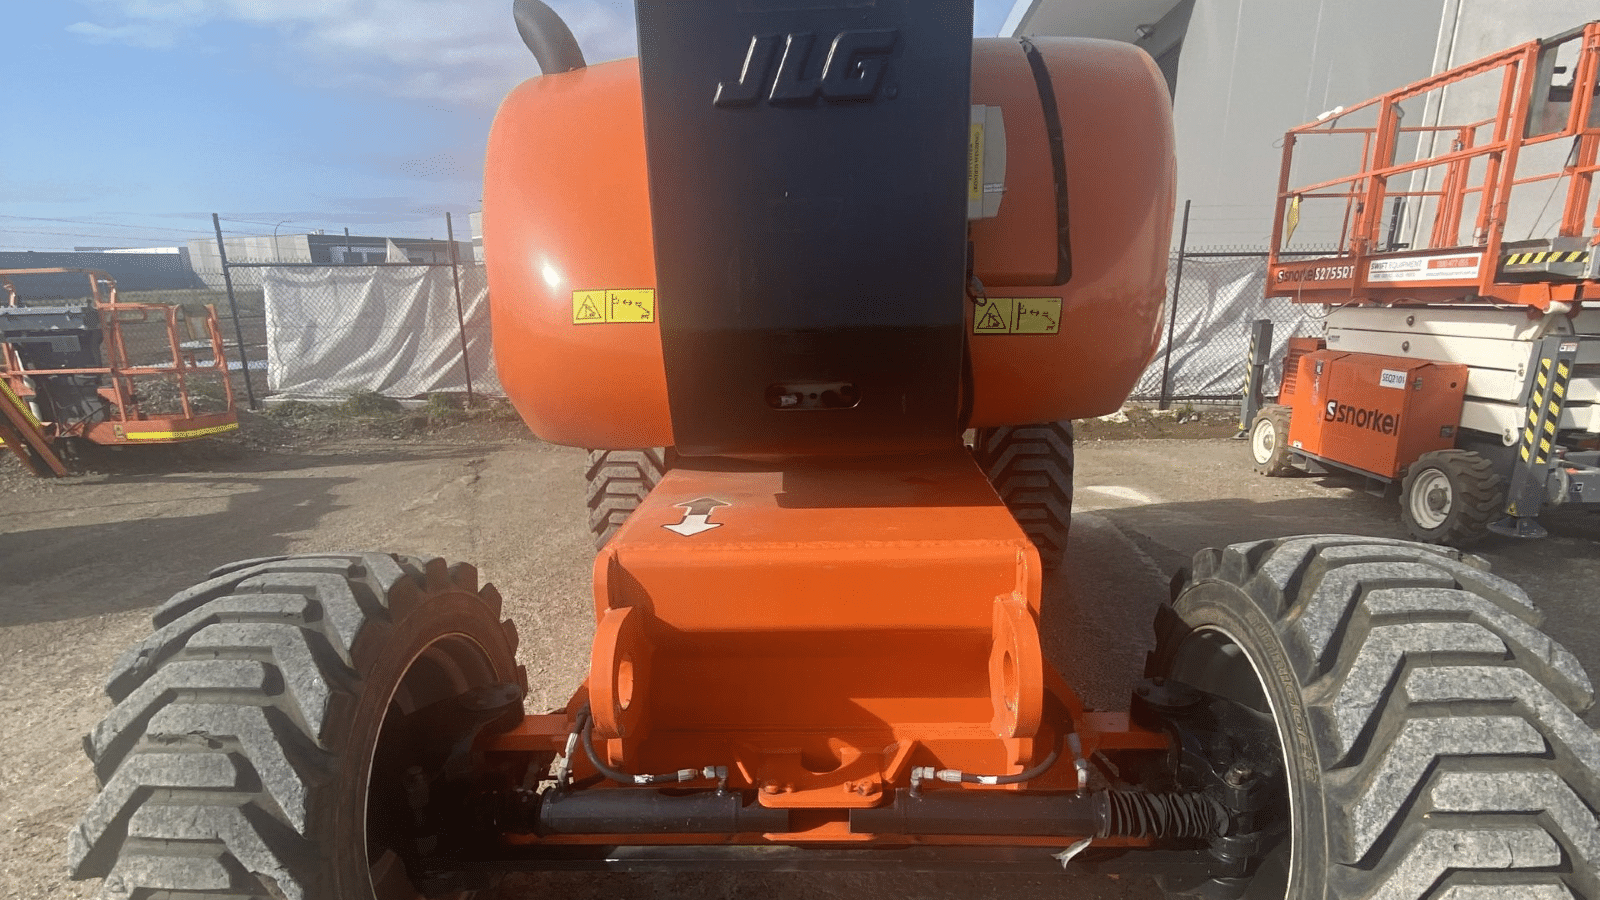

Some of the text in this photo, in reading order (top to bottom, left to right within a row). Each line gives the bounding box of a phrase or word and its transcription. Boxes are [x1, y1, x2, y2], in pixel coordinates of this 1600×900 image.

[713, 31, 898, 107] JLG
[1314, 265, 1355, 281] S2755RT
[1370, 262, 1388, 270] SWIFT
